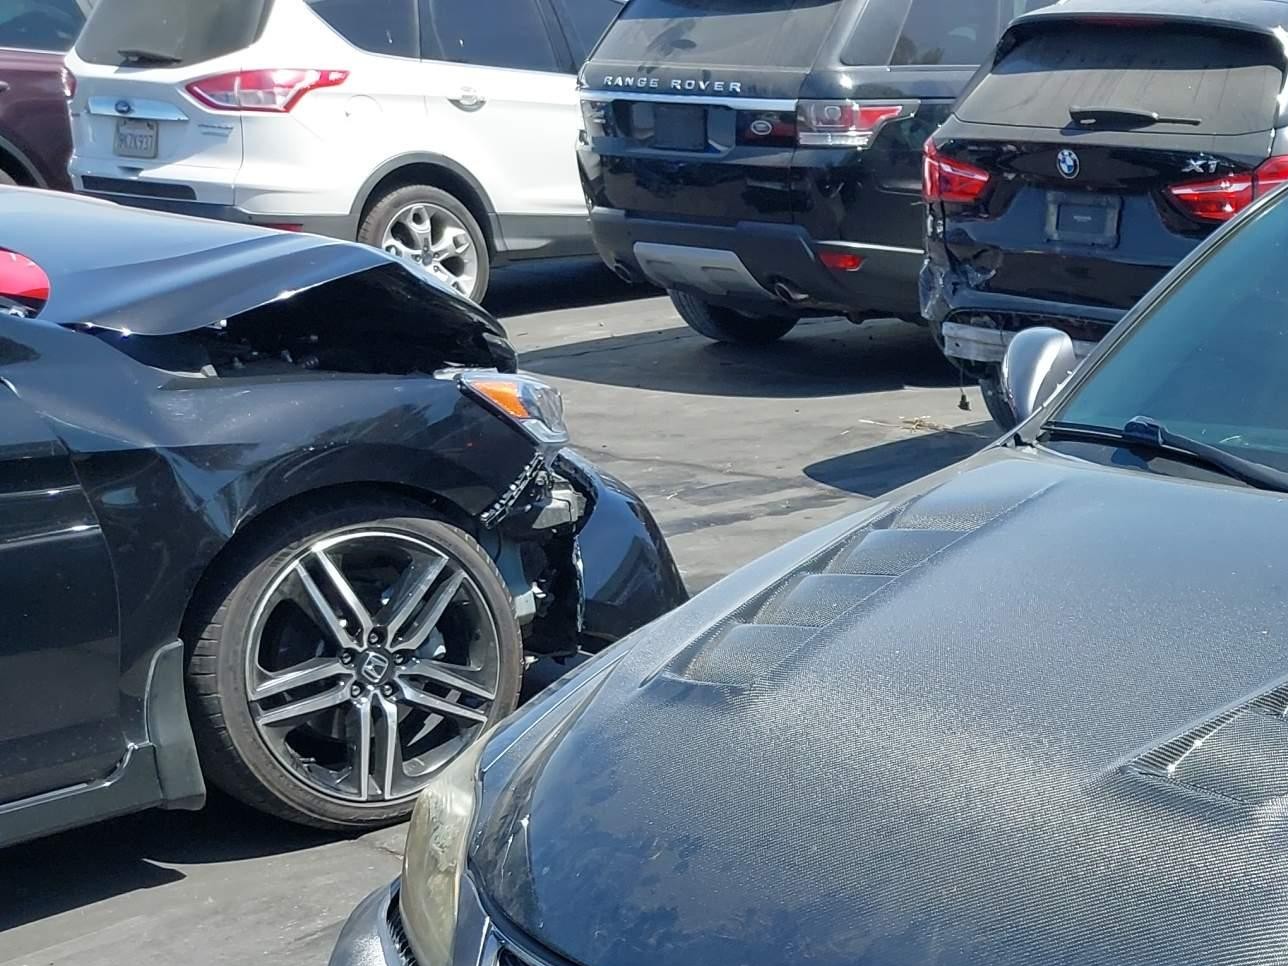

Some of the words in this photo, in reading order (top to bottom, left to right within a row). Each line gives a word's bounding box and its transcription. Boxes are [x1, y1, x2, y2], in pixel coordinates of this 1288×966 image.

[603, 76, 659, 88] RANGE
[670, 79, 742, 93] ROVER
[1181, 156, 1221, 173] X1
